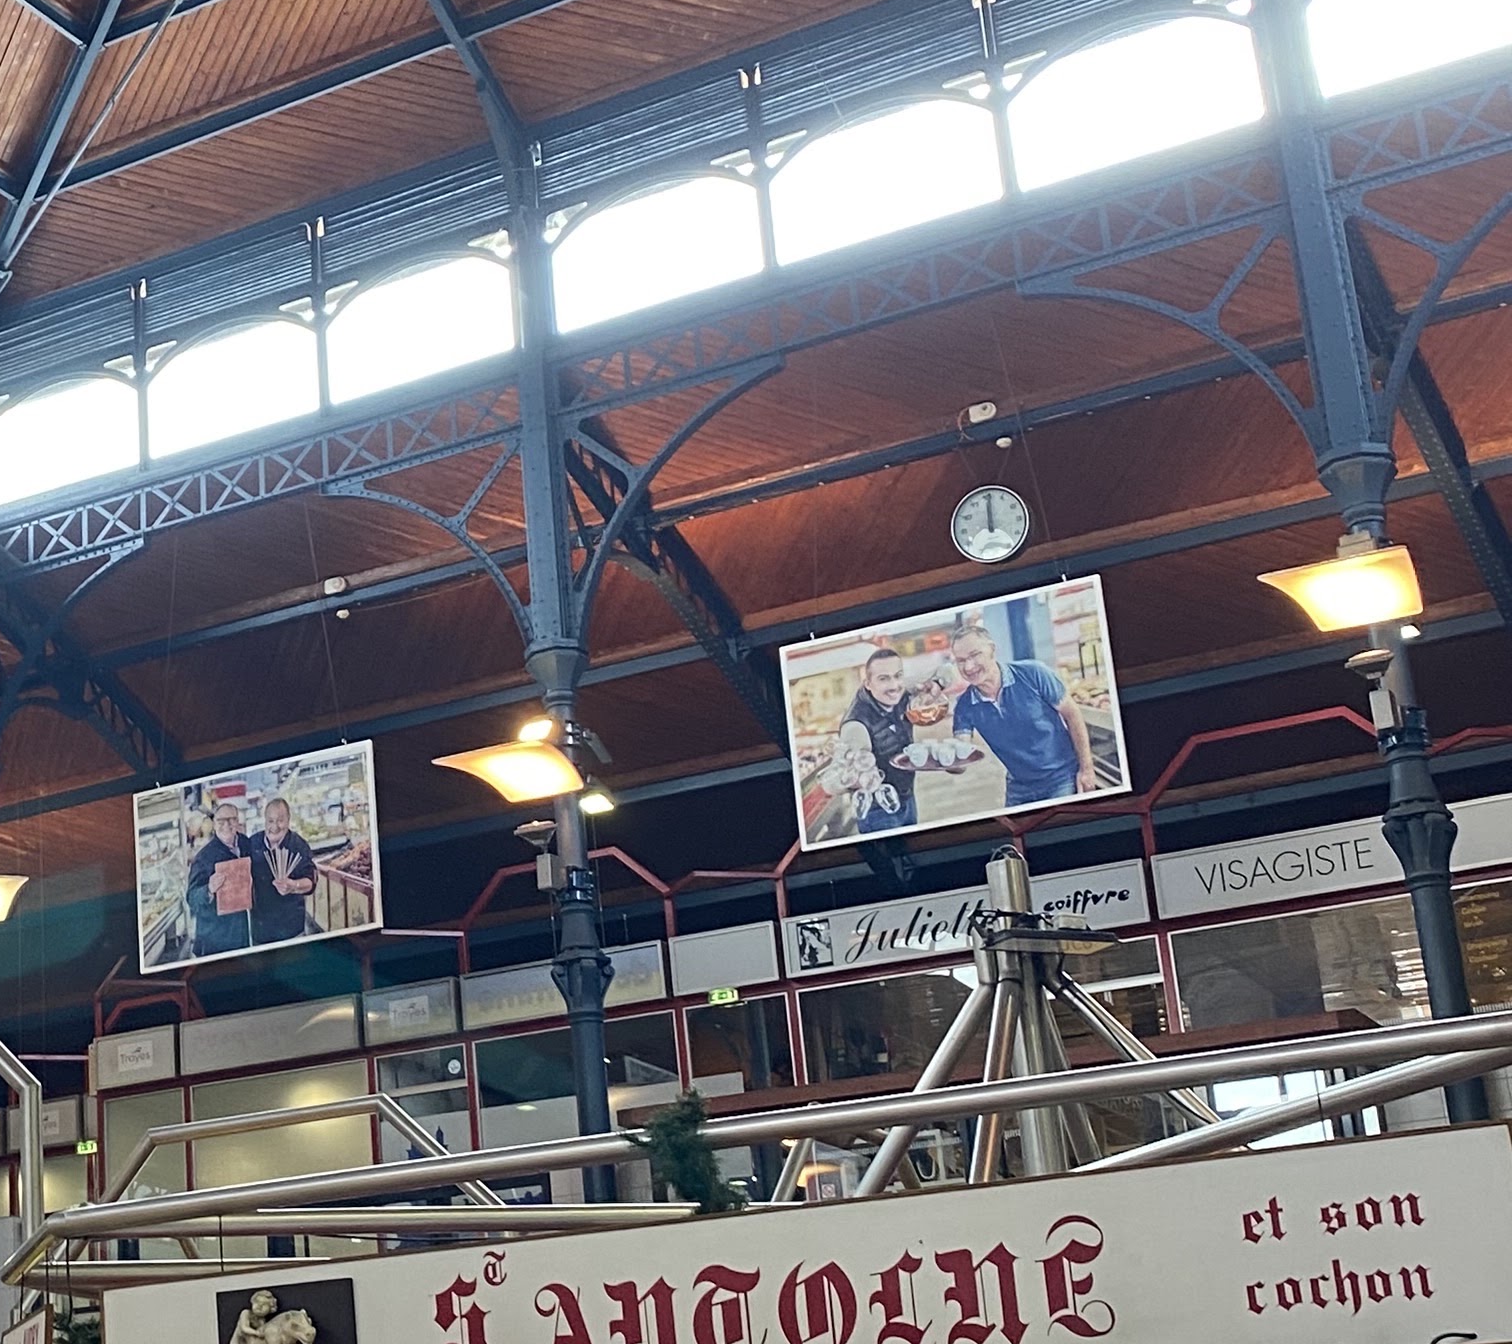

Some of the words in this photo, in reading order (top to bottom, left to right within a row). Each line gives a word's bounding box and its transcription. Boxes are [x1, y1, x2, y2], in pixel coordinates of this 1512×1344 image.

[1194, 838, 1374, 894] VISAGISTE
[844, 898, 991, 963] Juliett
[1241, 1195, 1287, 1245] et
[1319, 1191, 1427, 1236] son
[1245, 1258, 1435, 1316] cochon
